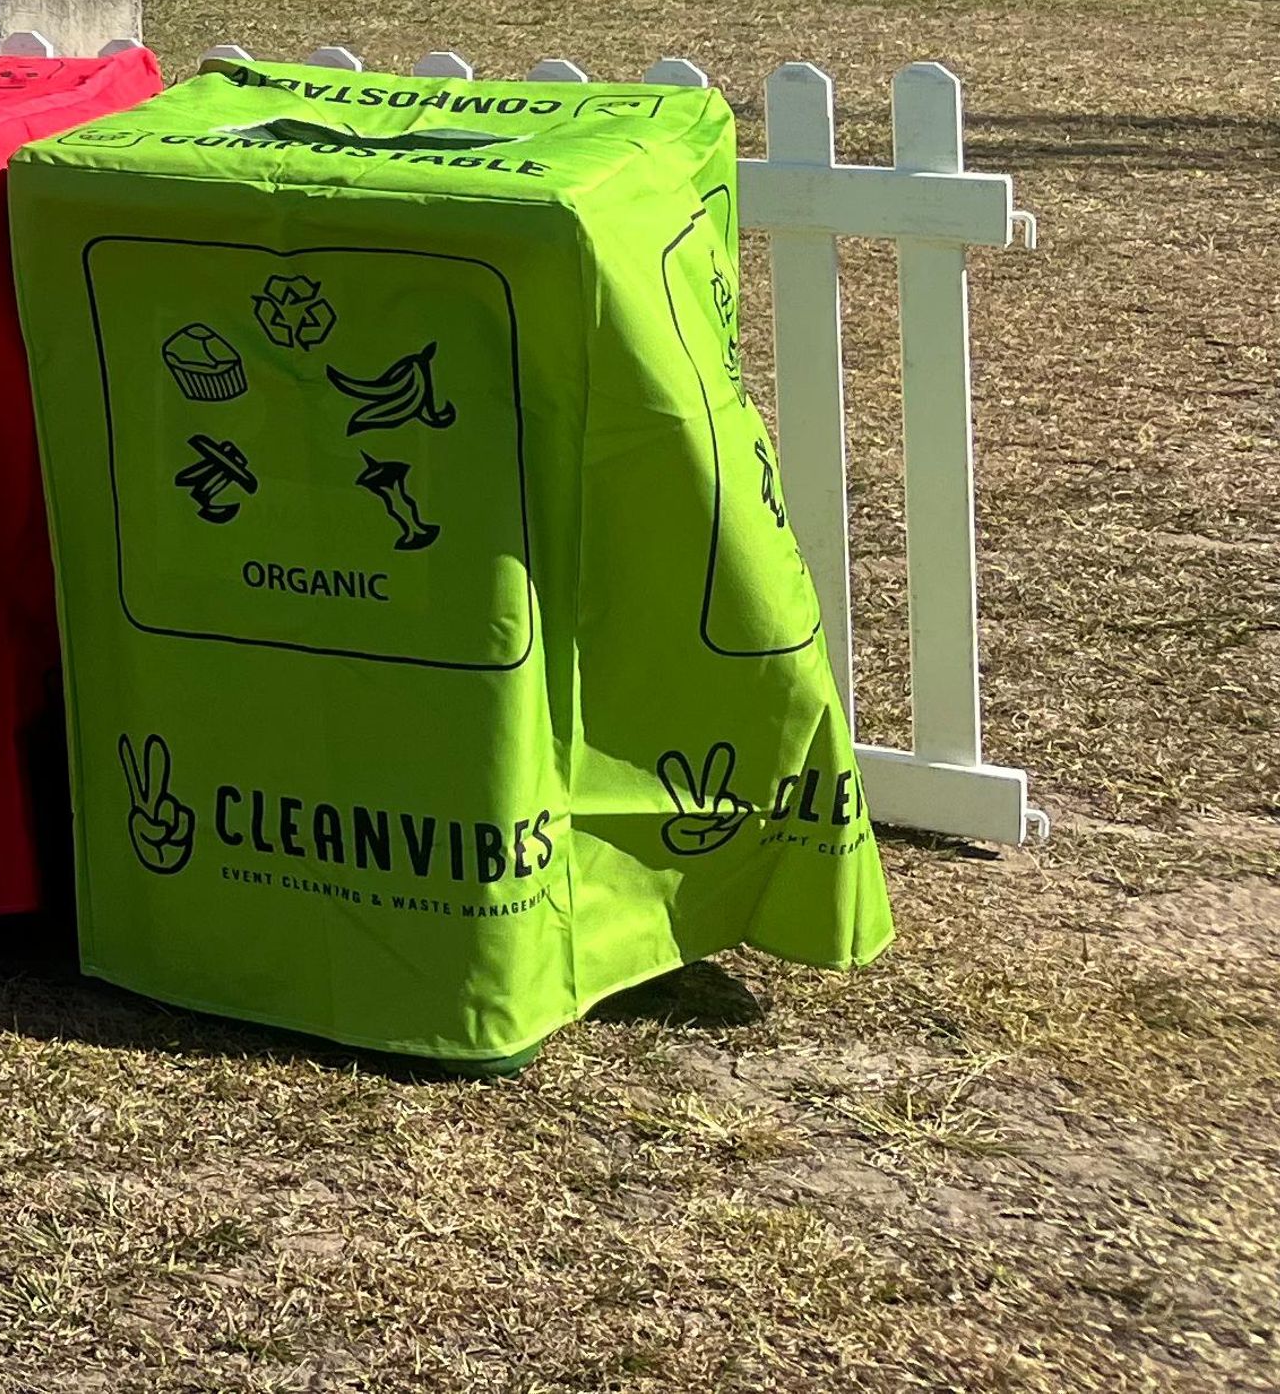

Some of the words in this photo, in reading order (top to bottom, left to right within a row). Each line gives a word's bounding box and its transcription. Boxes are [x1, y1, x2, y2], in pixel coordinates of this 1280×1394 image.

[241, 559, 390, 603] ORGANIC
[771, 769, 862, 825] CLE
[214, 783, 554, 884] CLEANVIBES
[221, 866, 273, 886] EVENT
[282, 875, 362, 904] CLEANING
[371, 893, 383, 907] &
[392, 895, 452, 916] WASTE
[462, 883, 552, 918] MANAGEMENT
